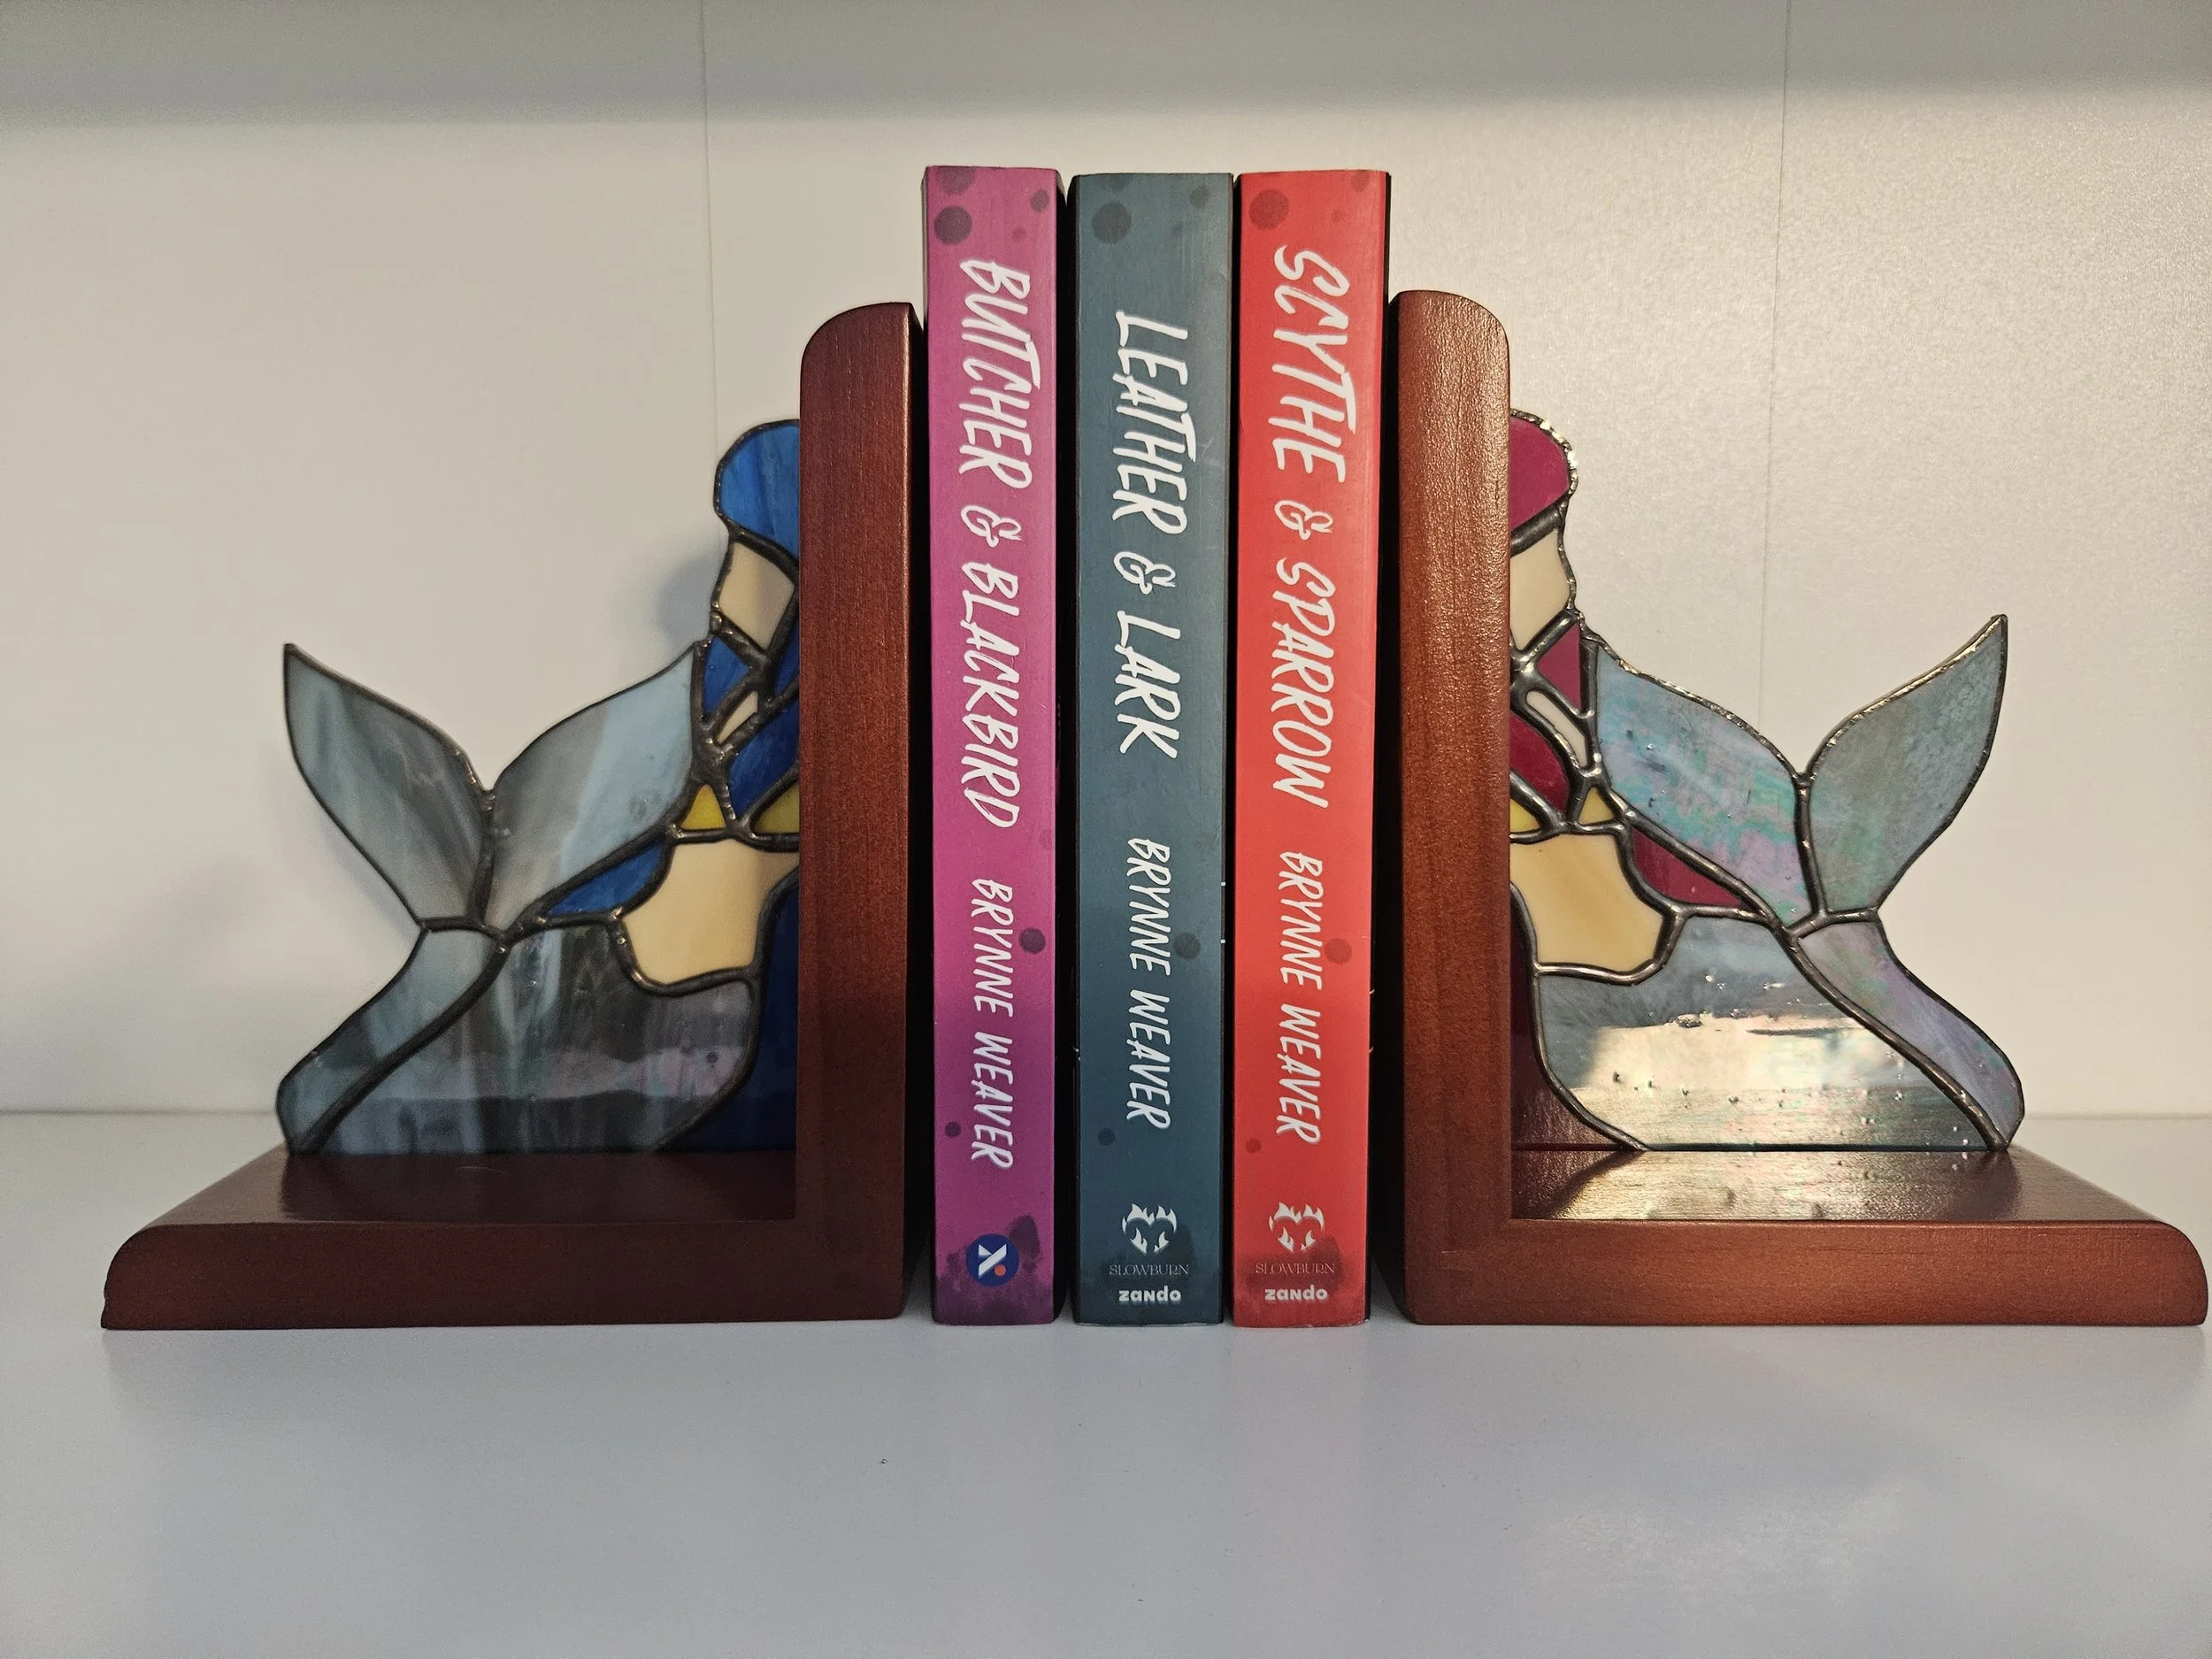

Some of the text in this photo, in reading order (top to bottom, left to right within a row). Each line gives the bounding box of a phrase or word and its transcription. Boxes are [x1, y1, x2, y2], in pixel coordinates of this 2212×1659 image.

[958, 259, 1041, 828] BUTCHER & BLACKBIRD
[1111, 311, 1197, 759] LEATHER & LARK
[1268, 245, 1357, 809] SCYTHE & SPARROW
[971, 879, 1014, 1169] BRYNNE WEAVER
[1126, 837, 1171, 1129] BRYNNE WEAVER
[1276, 851, 1325, 1143] BRYNNE WEAVER
[1109, 1263, 1188, 1276] SLOWBURN
[1256, 1263, 1335, 1275] SLOWBURN
